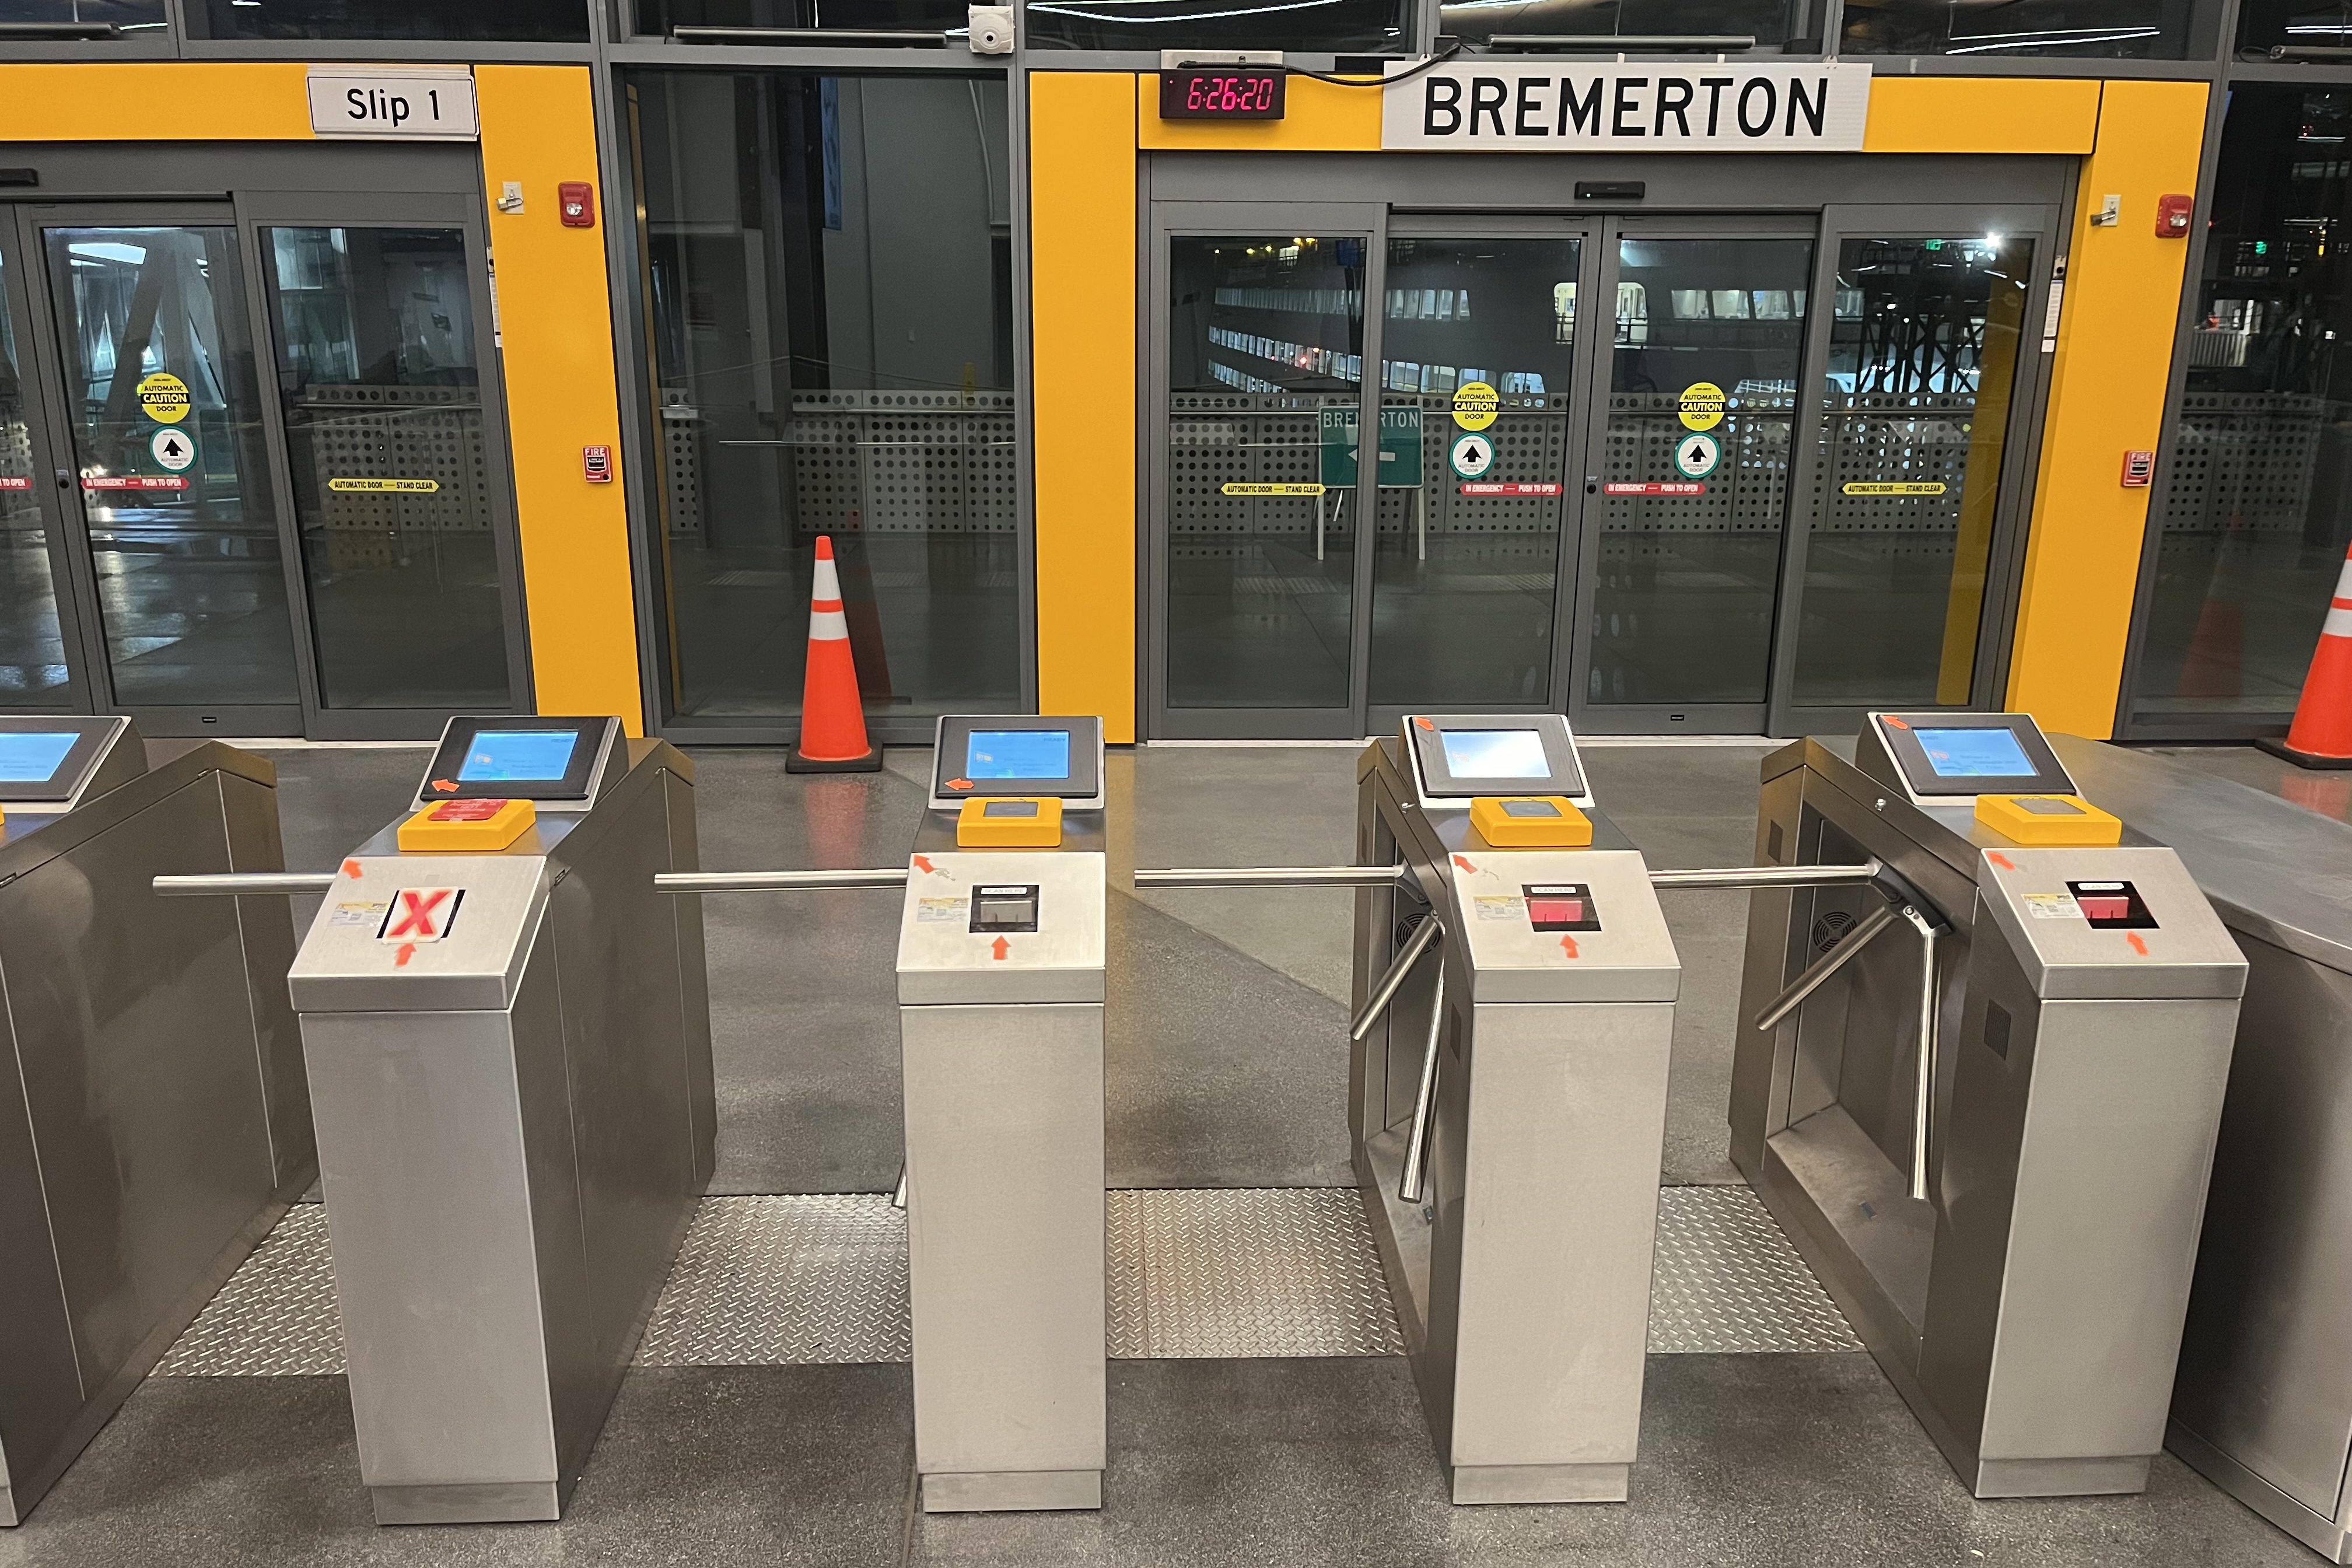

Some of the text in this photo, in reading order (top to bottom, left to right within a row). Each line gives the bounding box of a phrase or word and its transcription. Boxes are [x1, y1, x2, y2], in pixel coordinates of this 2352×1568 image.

[1187, 78, 1274, 110] 6:26:20
[346, 88, 439, 128] Slip 1
[1423, 76, 1828, 138] BREMERTON
[143, 394, 187, 403] CAUTION
[1454, 402, 1496, 411] CAUTION
[1681, 402, 1723, 411] CAUTION
[1323, 412, 1419, 428] BRERTON
[93, 478, 126, 487] EMERGENCY
[142, 478, 158, 487] PUSH
[158, 478, 166, 487] TO
[166, 478, 181, 487] OPEN
[1472, 484, 1504, 492] EMERGENCY
[1518, 484, 1533, 492] PUSH
[1534, 484, 1541, 492] TO
[1541, 484, 1556, 492] OPEN
[1615, 484, 1647, 492] EMERGENCY
[1661, 484, 1675, 492] PUSH
[1676, 484, 1684, 492] TO
[1684, 484, 1698, 492] OPEN
